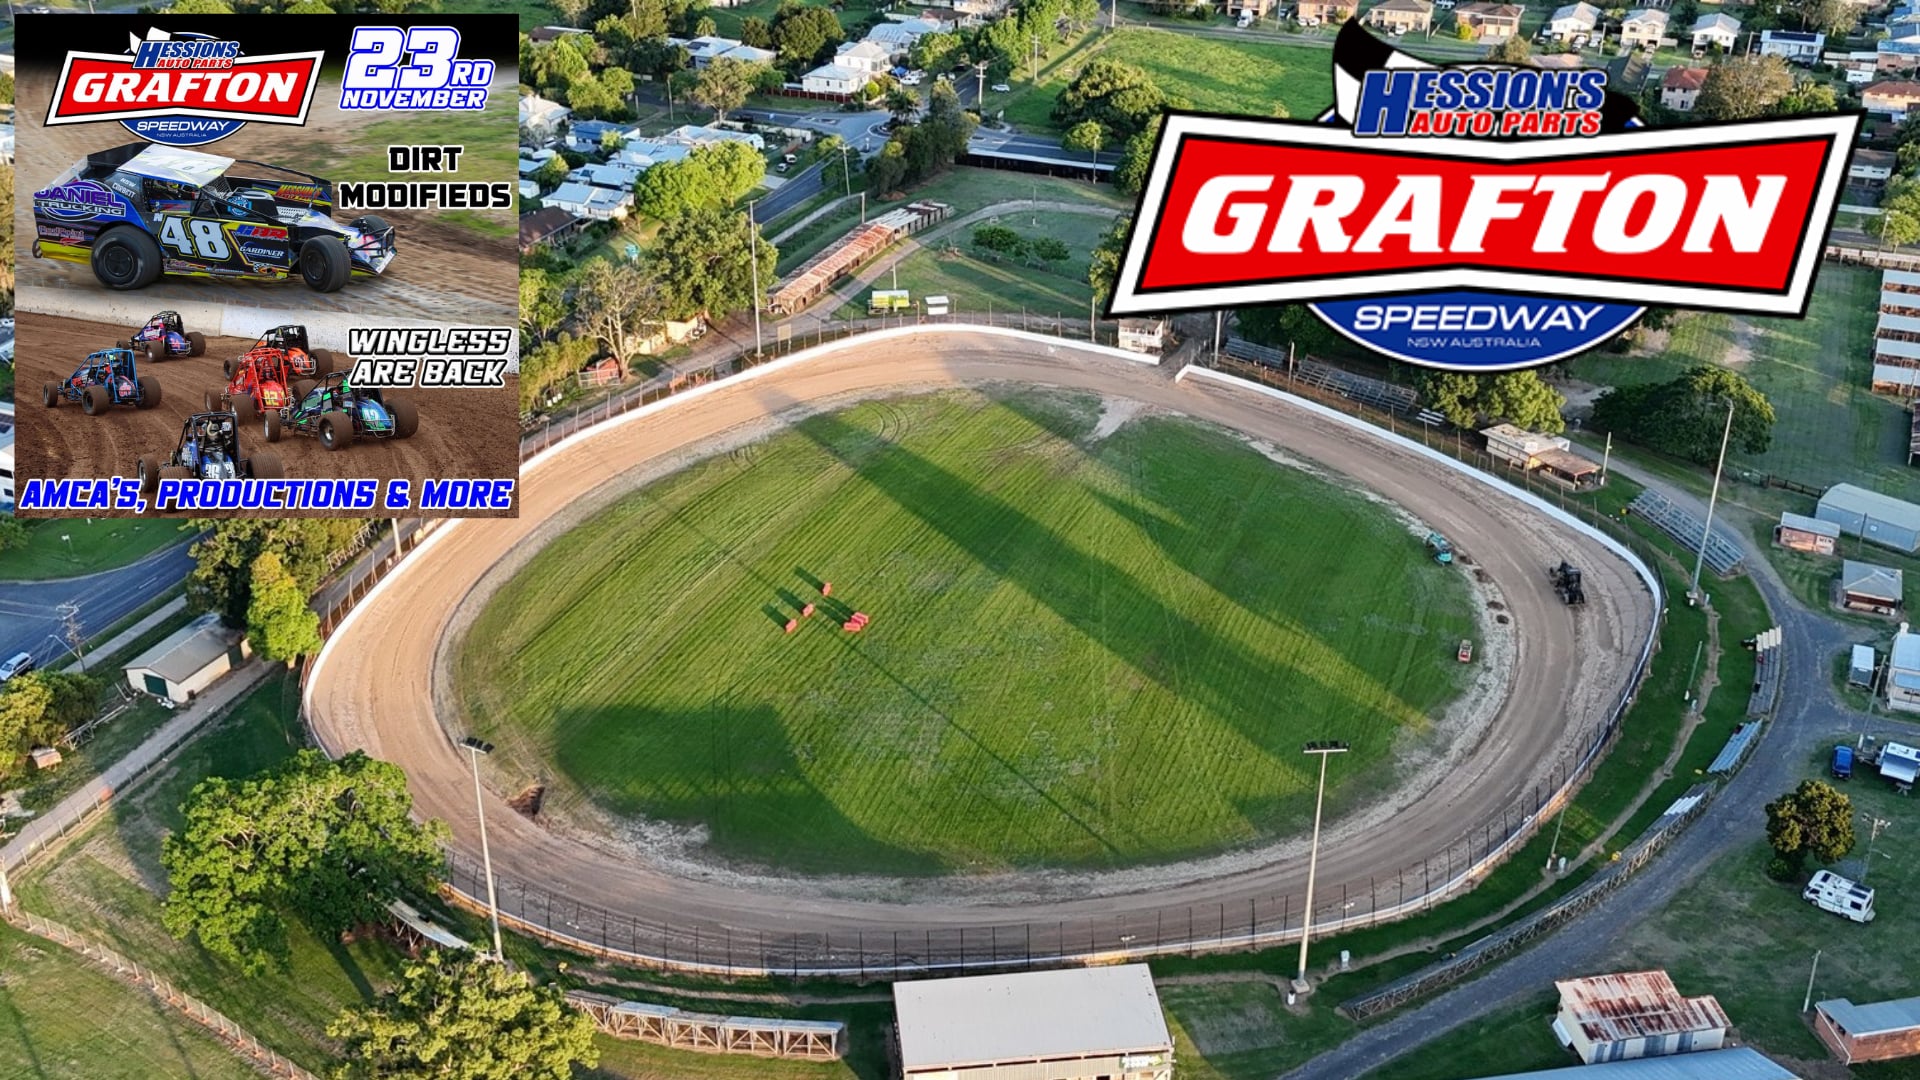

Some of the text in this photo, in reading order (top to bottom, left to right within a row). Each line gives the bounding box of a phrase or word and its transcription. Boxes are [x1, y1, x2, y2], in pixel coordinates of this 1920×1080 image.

[34, 186, 126, 208] DANIEL
[40, 200, 122, 215] TRUCKING
[160, 216, 231, 259] 48
[240, 245, 284, 257] GARDINER
